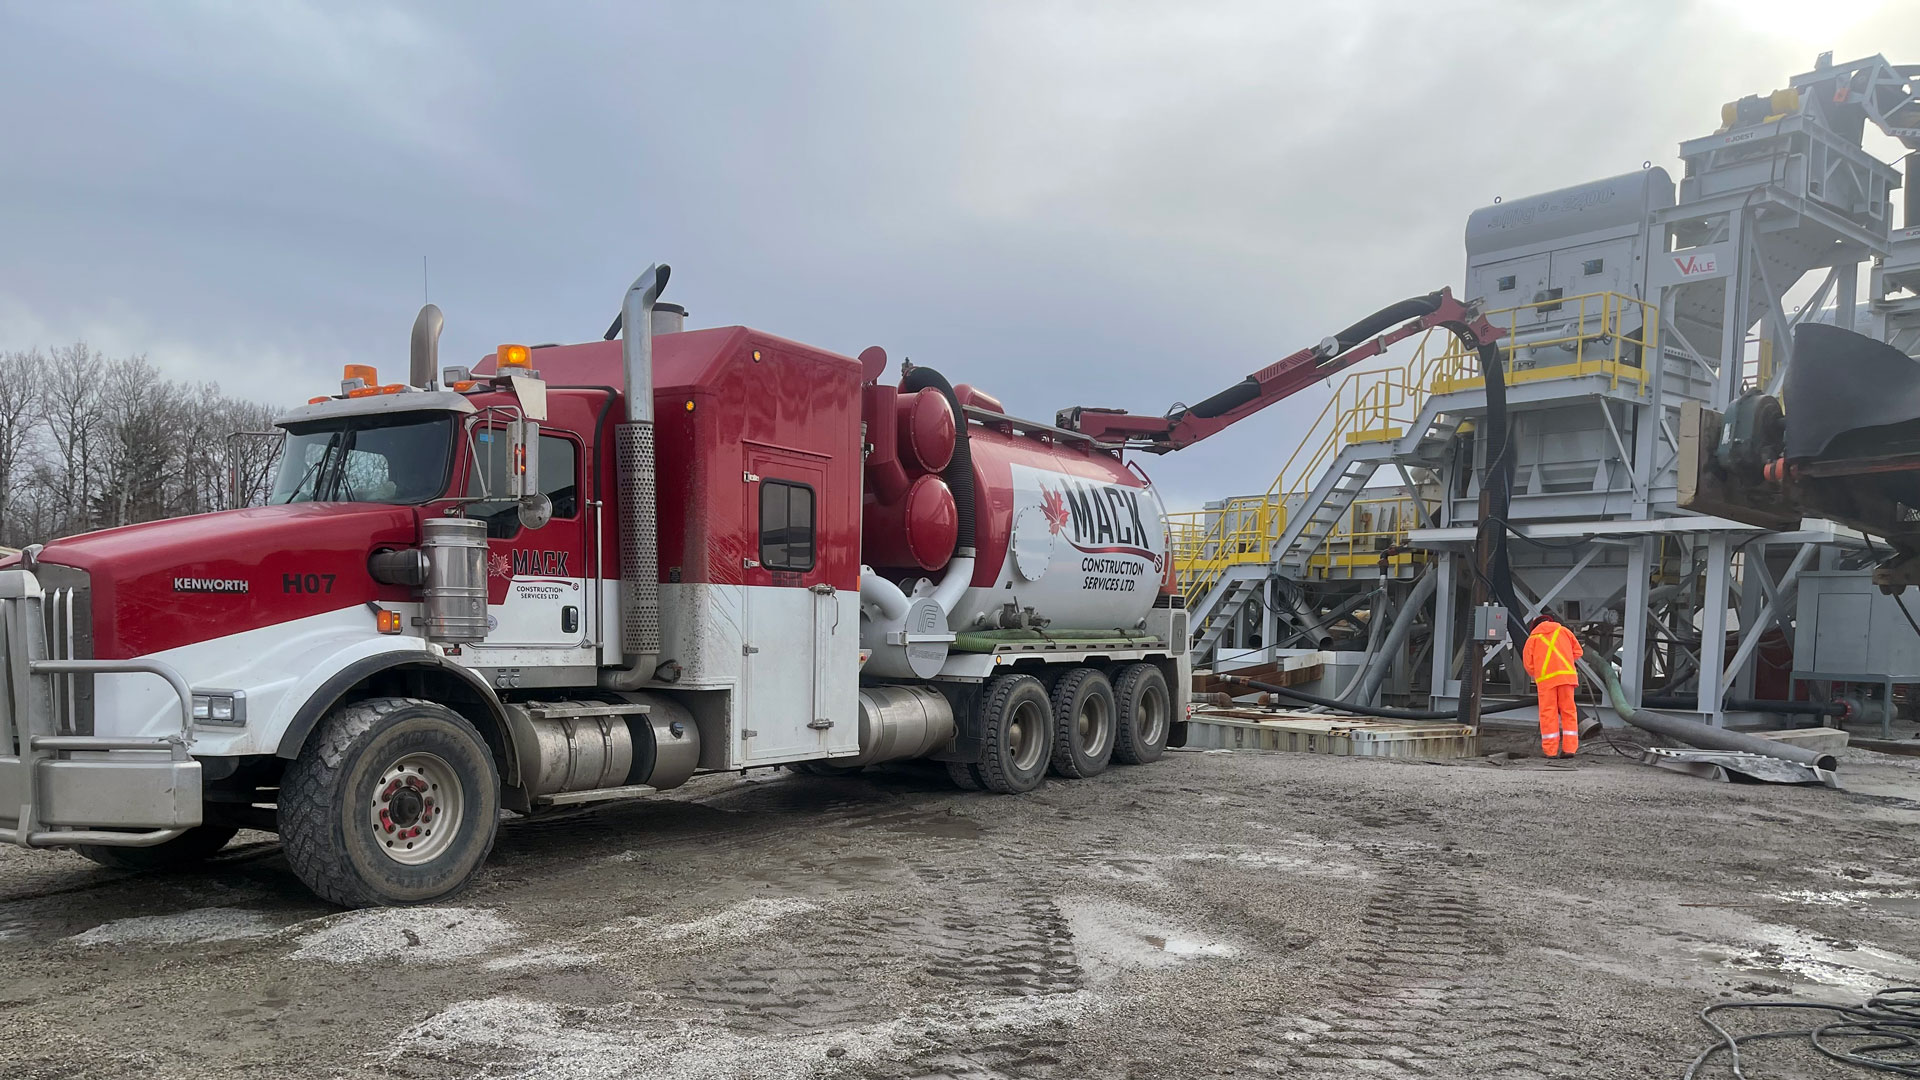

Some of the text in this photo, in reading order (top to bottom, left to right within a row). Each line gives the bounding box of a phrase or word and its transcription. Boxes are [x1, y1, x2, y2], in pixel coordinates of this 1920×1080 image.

[1673, 255, 1716, 275] VALE
[1059, 478, 1149, 550] MACK
[512, 549, 569, 577] MACK
[1081, 557, 1145, 576] CONSTRUCTION
[174, 577, 249, 592] KENWORTH
[282, 573, 337, 594] H07
[516, 585, 563, 593] CONSTRUCTION
[1082, 576, 1135, 592] SERVICES LTD.
